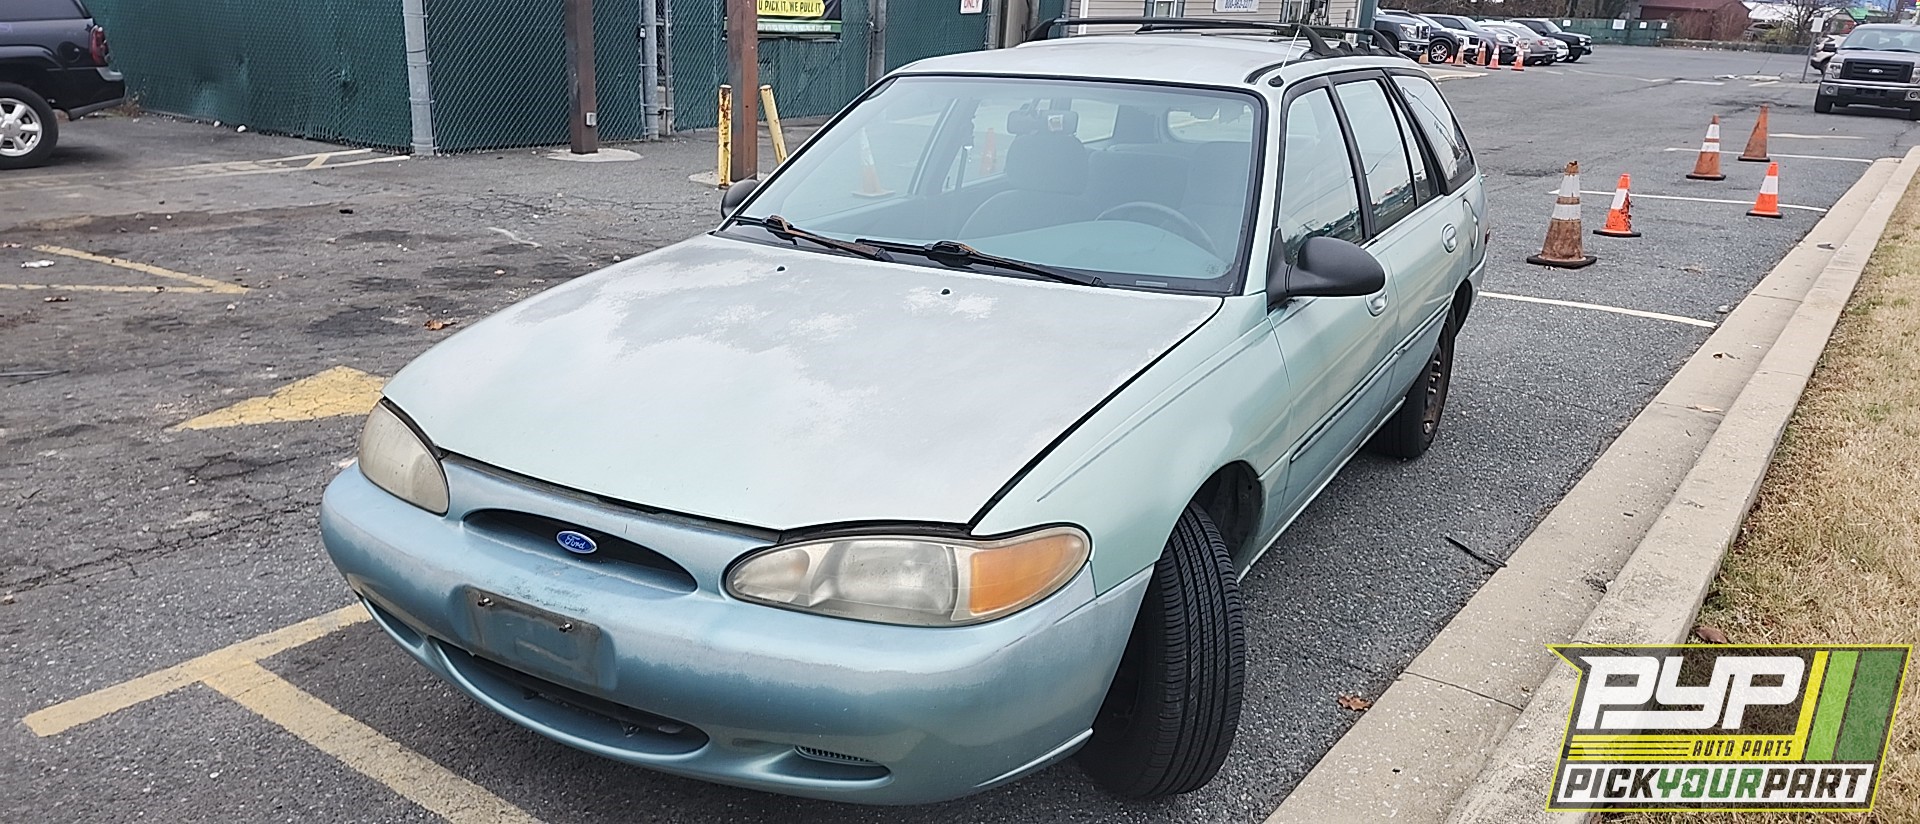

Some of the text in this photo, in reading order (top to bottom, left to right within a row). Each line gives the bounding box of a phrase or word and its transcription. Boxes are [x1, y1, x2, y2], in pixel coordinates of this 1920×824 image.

[764, 0, 780, 12] PICK
[790, 1, 799, 12] WE
[800, 1, 814, 13] PULL
[815, 2, 822, 13] IT
